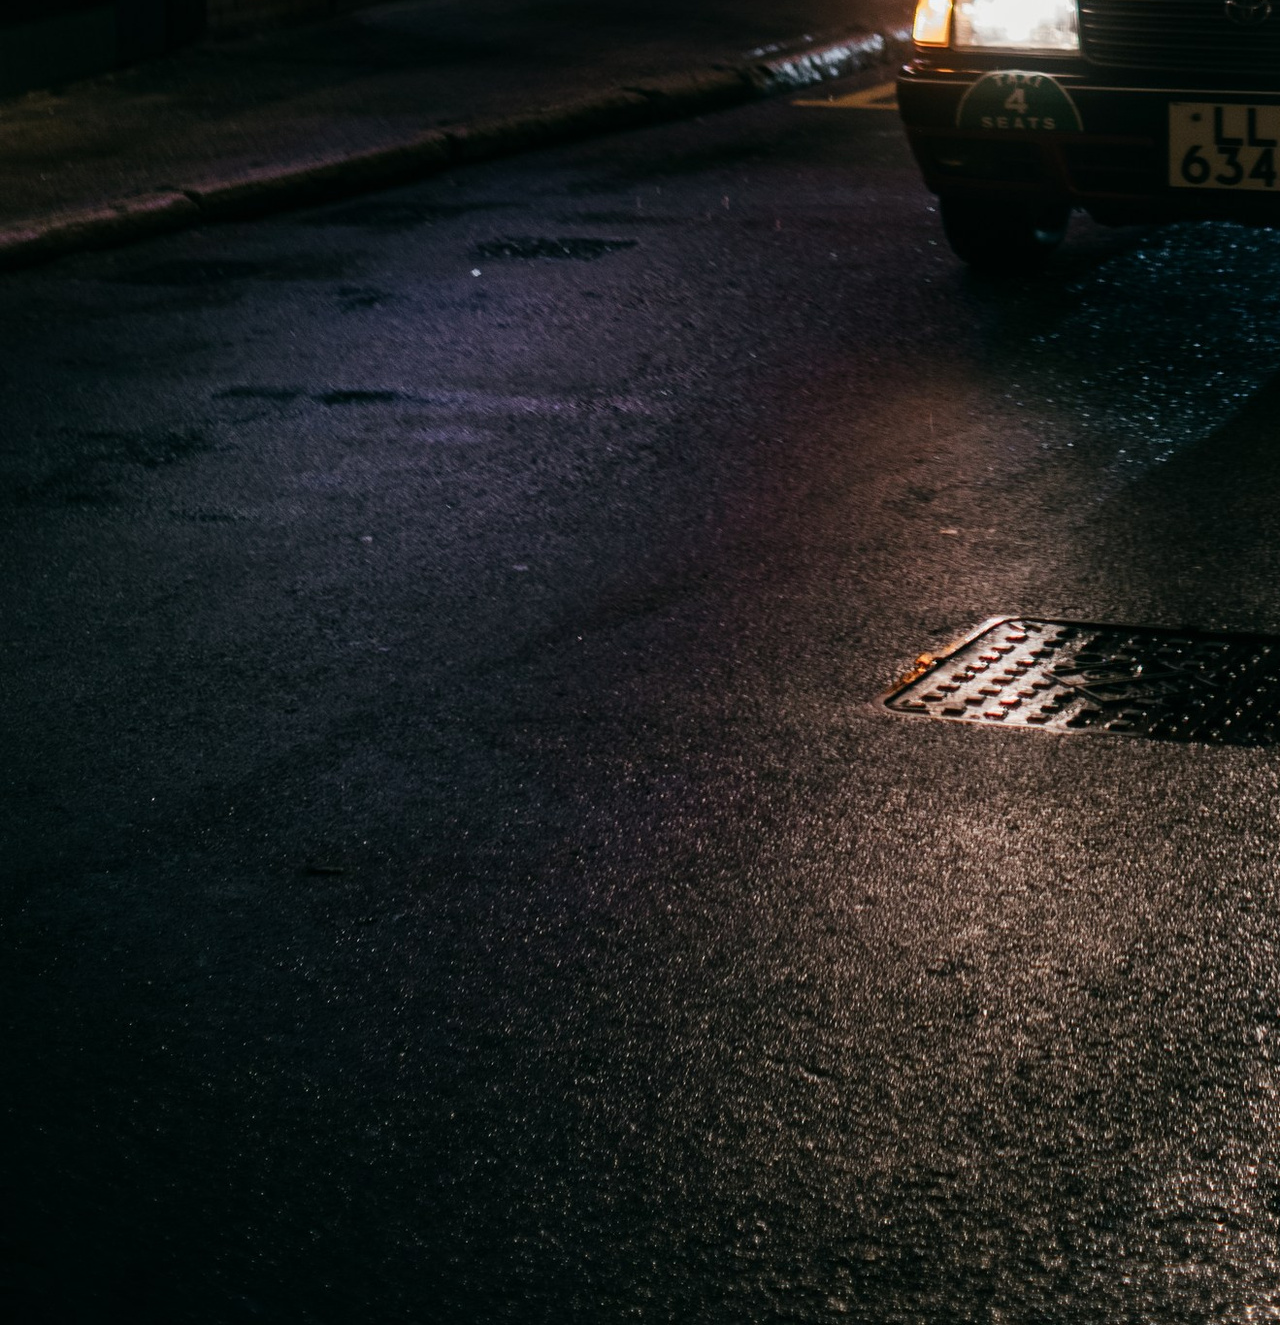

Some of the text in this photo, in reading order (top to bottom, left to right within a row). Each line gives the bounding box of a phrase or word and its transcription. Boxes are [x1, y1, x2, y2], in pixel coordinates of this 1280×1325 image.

[1004, 88, 1028, 114] 4
[981, 115, 1056, 130] SEATS
[1214, 107, 1277, 147] LL
